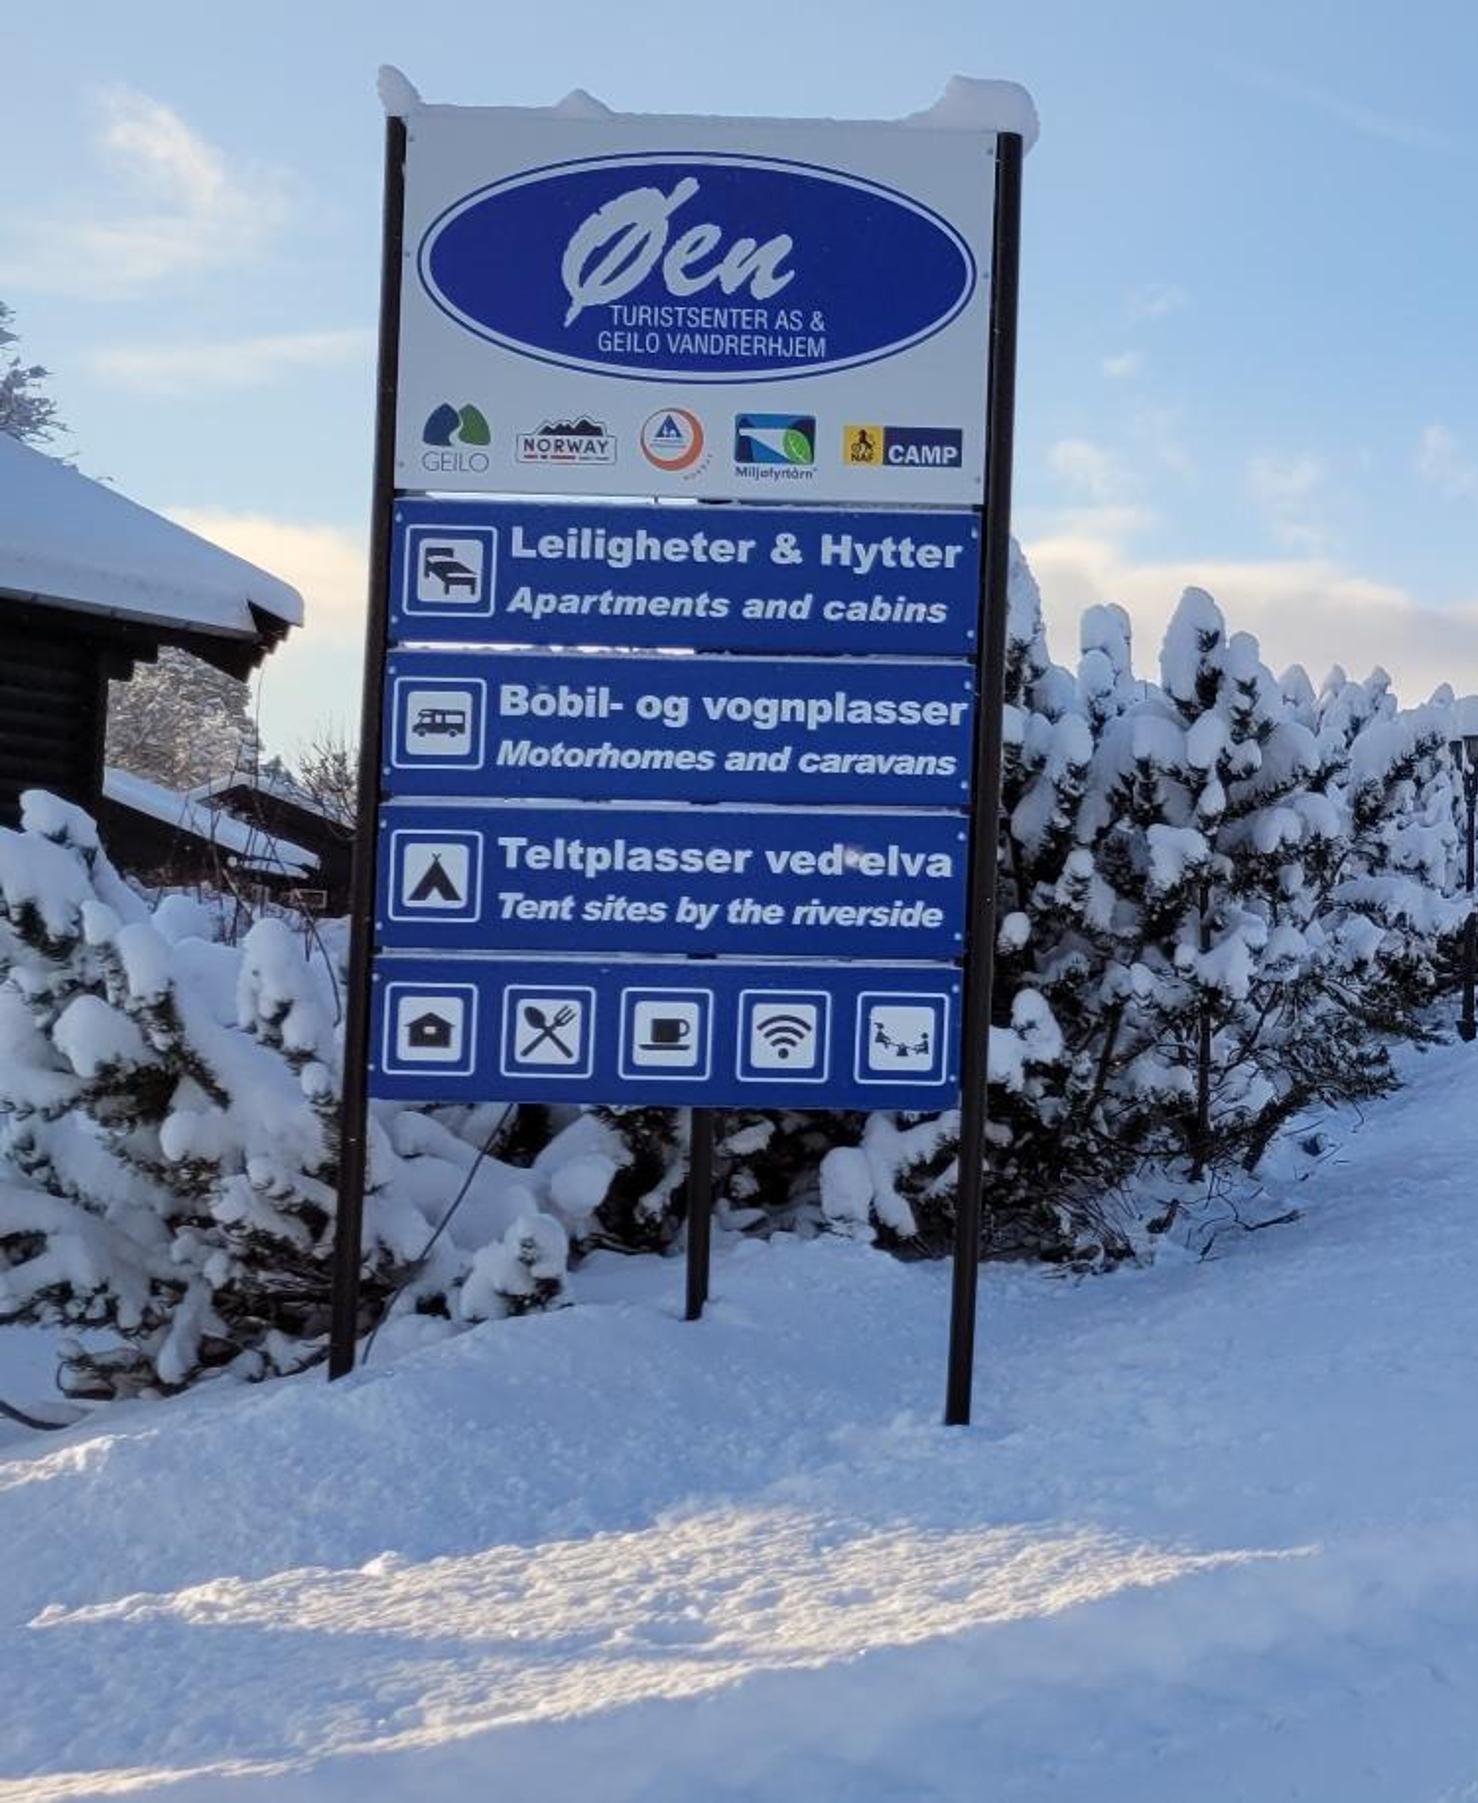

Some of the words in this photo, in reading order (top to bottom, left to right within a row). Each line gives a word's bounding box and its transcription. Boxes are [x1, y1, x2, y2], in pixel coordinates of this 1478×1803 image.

[560, 177, 795, 328] Øen
[608, 305, 768, 330] TURISTSENTER
[774, 309, 803, 331] AS
[809, 311, 826, 332] &
[598, 331, 660, 353] GEILO
[667, 333, 826, 358] VANDRERHJEM
[422, 452, 490, 473] GEILO
[523, 438, 609, 454] NORWAY
[888, 445, 959, 465] CAMP
[511, 526, 756, 568] Leiligheter
[769, 533, 804, 565] &
[821, 535, 963, 574] Hytter
[507, 587, 730, 620] Apartments
[742, 594, 812, 620] and
[823, 596, 948, 623] cabins
[636, 695, 690, 728] og
[703, 693, 969, 730] vognplasser
[496, 740, 715, 772] Motorhomes
[725, 747, 792, 773] and
[798, 753, 957, 776] caravans
[498, 837, 752, 878] Teltplasser
[765, 843, 844, 876] ved
[858, 845, 953, 878] elva
[498, 893, 575, 921] Tent
[584, 895, 667, 924] sites
[676, 895, 718, 930] by
[727, 899, 784, 925] the
[792, 901, 945, 929] riverside
